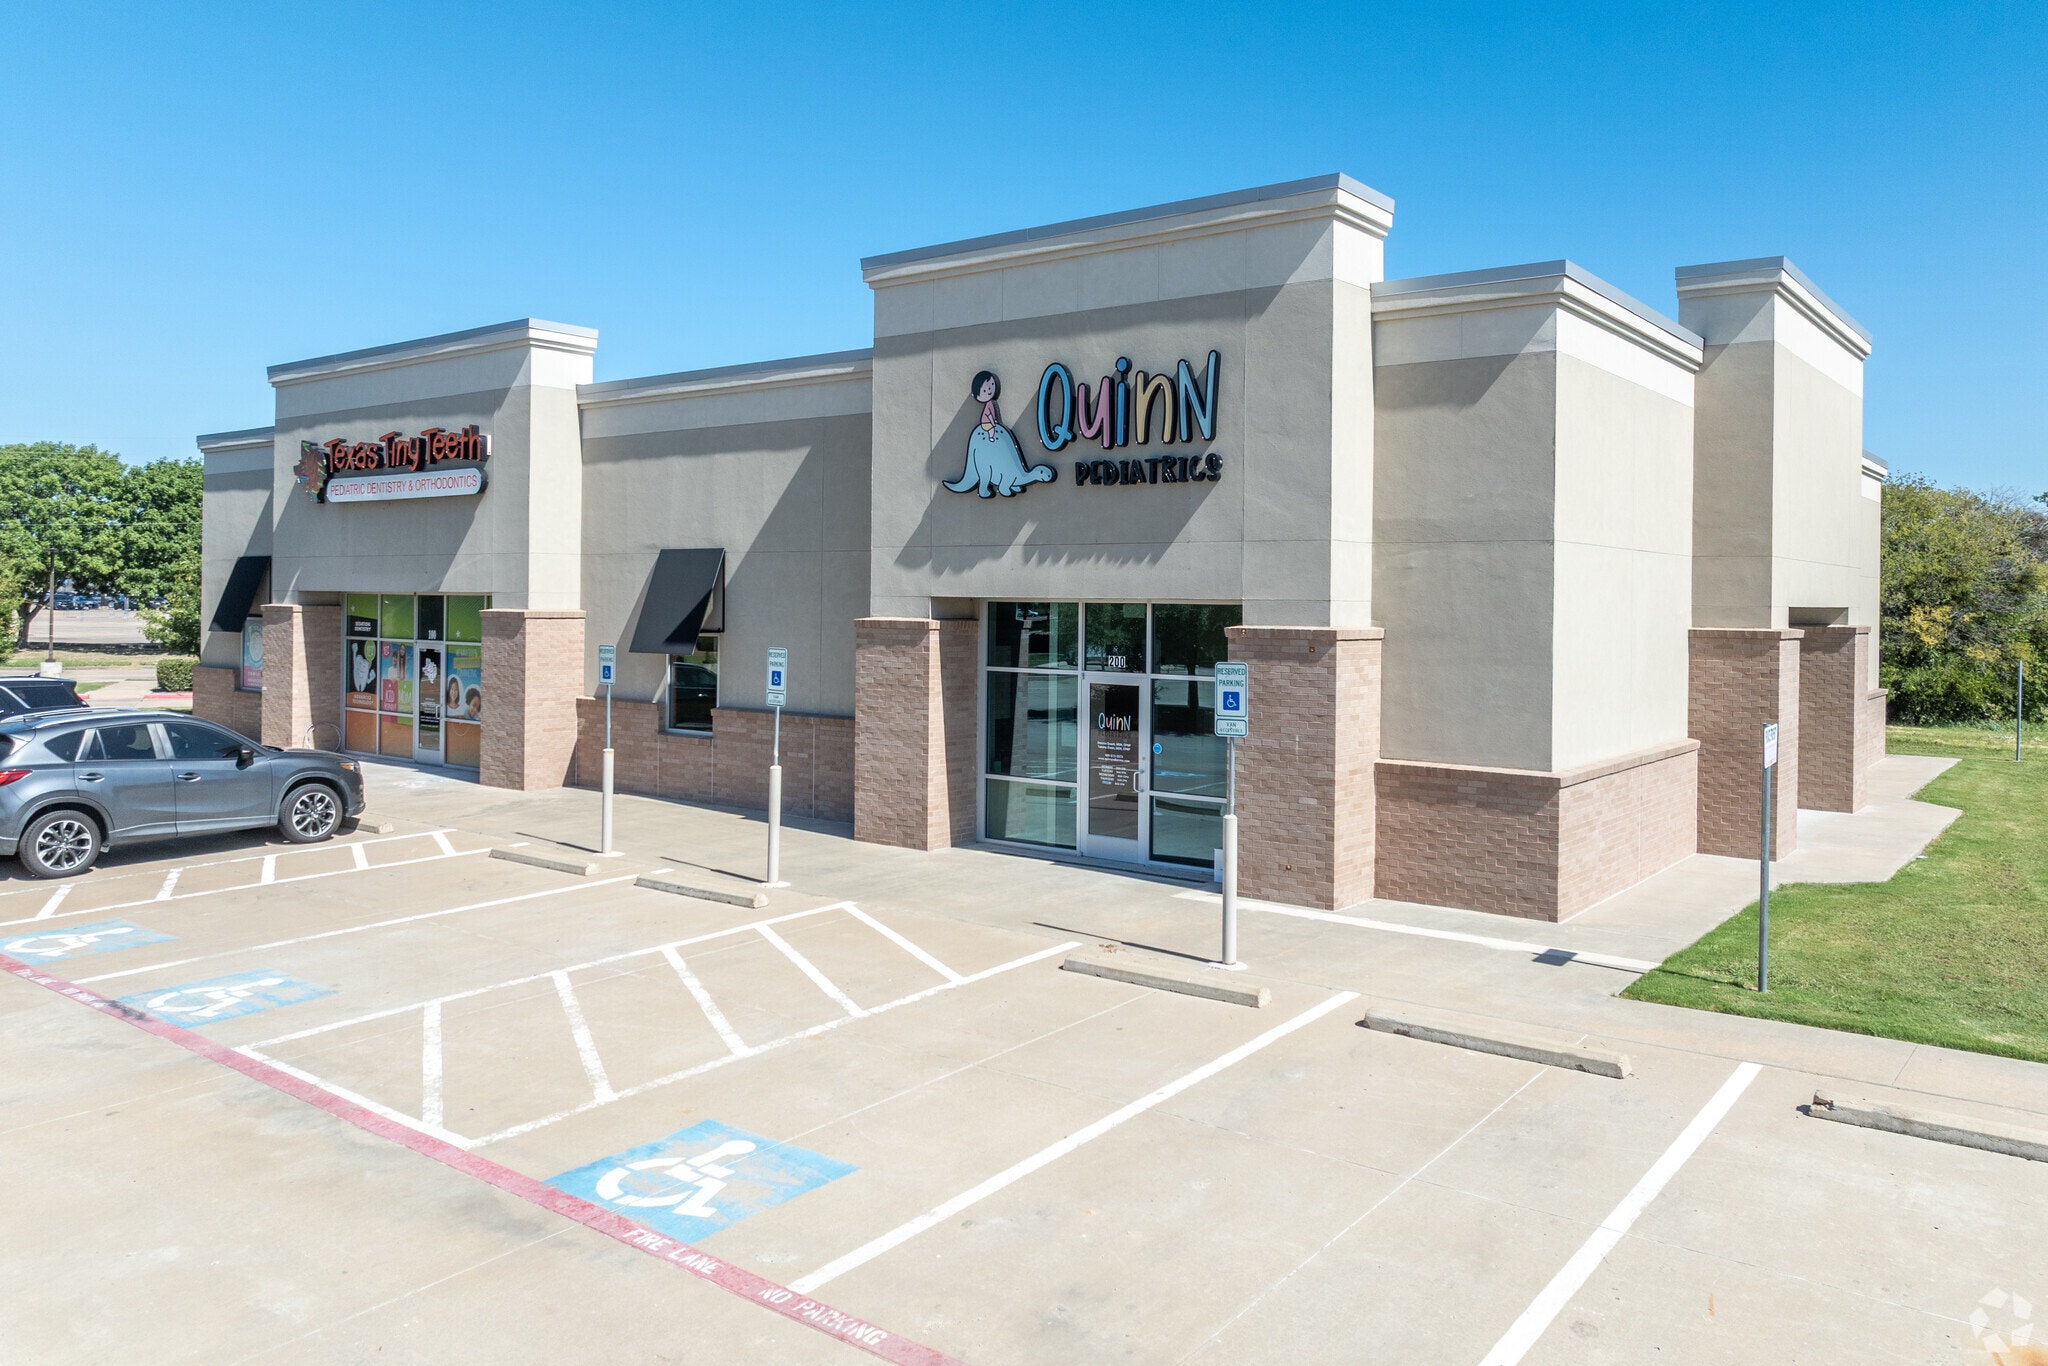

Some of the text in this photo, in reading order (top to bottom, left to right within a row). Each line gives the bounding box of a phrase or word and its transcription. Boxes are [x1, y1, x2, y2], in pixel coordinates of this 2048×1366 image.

[1037, 349, 1220, 450] QuinN
[324, 424, 481, 473] Texas Tiny Teeth
[1075, 453, 1223, 486] PEDIATRICS
[330, 475, 478, 496] PEDIATRIC DENTISTRY & ORTHODONTICS
[1109, 656, 1126, 668] 200
[1217, 667, 1246, 676] RESERVED
[1219, 679, 1244, 687] PARKING
[1098, 712, 1131, 731] QuinN
[622, 1228, 888, 1346] FIRE LANE NO PARKING
